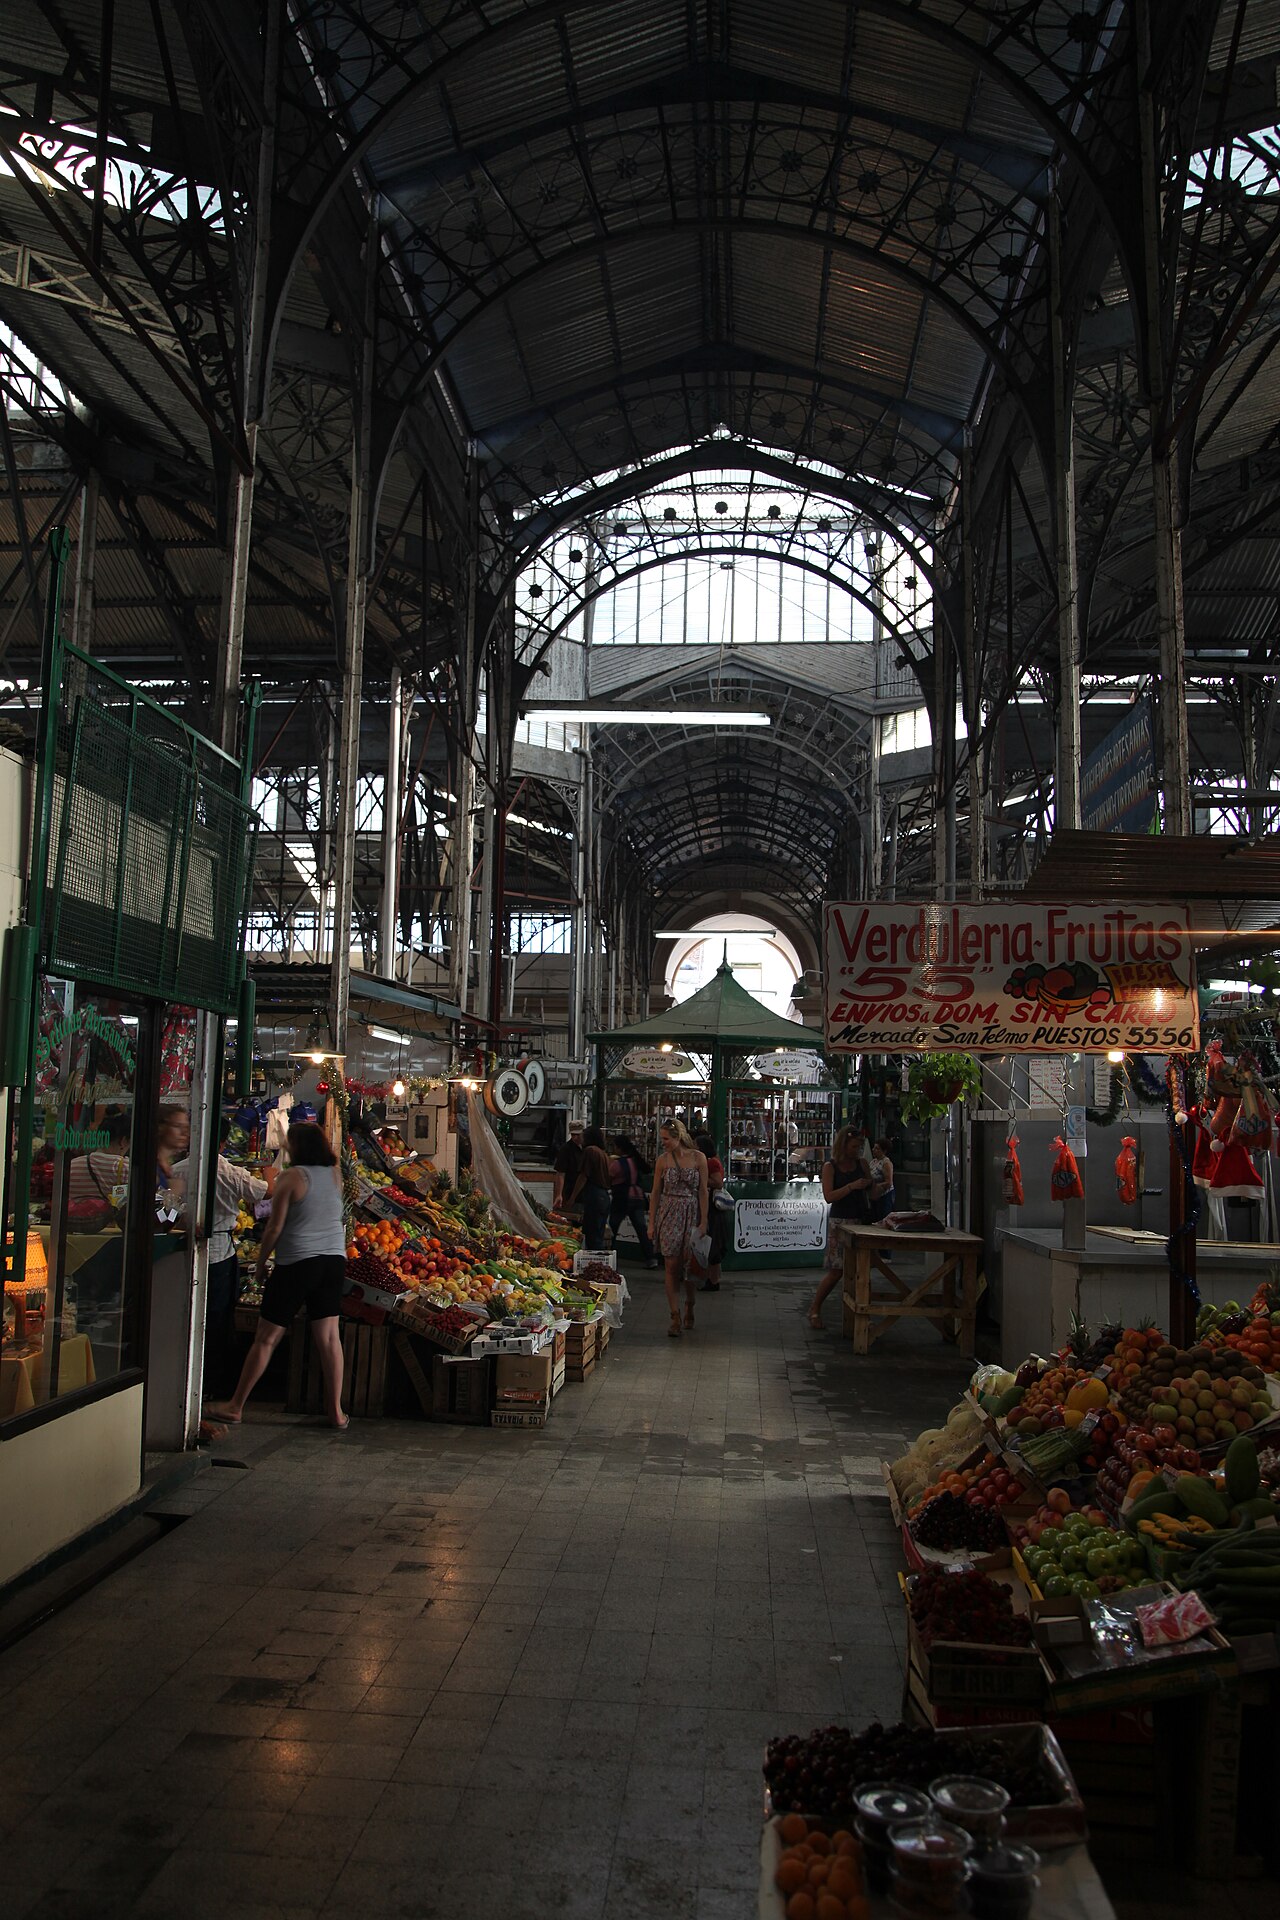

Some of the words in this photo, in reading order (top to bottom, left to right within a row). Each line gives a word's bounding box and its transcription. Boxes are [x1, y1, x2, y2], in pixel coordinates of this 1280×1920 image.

[1111, 964, 1178, 985] FRESH
[830, 1002, 922, 1025] ENVIOS
[919, 1010, 930, 1023] a
[932, 1002, 1000, 1024] DOM.
[1010, 1002, 1070, 1024] SIN
[1084, 1003, 1178, 1026] CARGO
[830, 1025, 930, 1044] Mercado
[933, 1024, 979, 1044] San
[980, 1024, 1030, 1045] Telmo
[1031, 1026, 1121, 1046] PUESTOS
[55, 1122, 80, 1150] Todo
[82, 1129, 111, 1148] casero
[494, 1414, 524, 1425] PIRATAS
[529, 1416, 542, 1425] LOS
